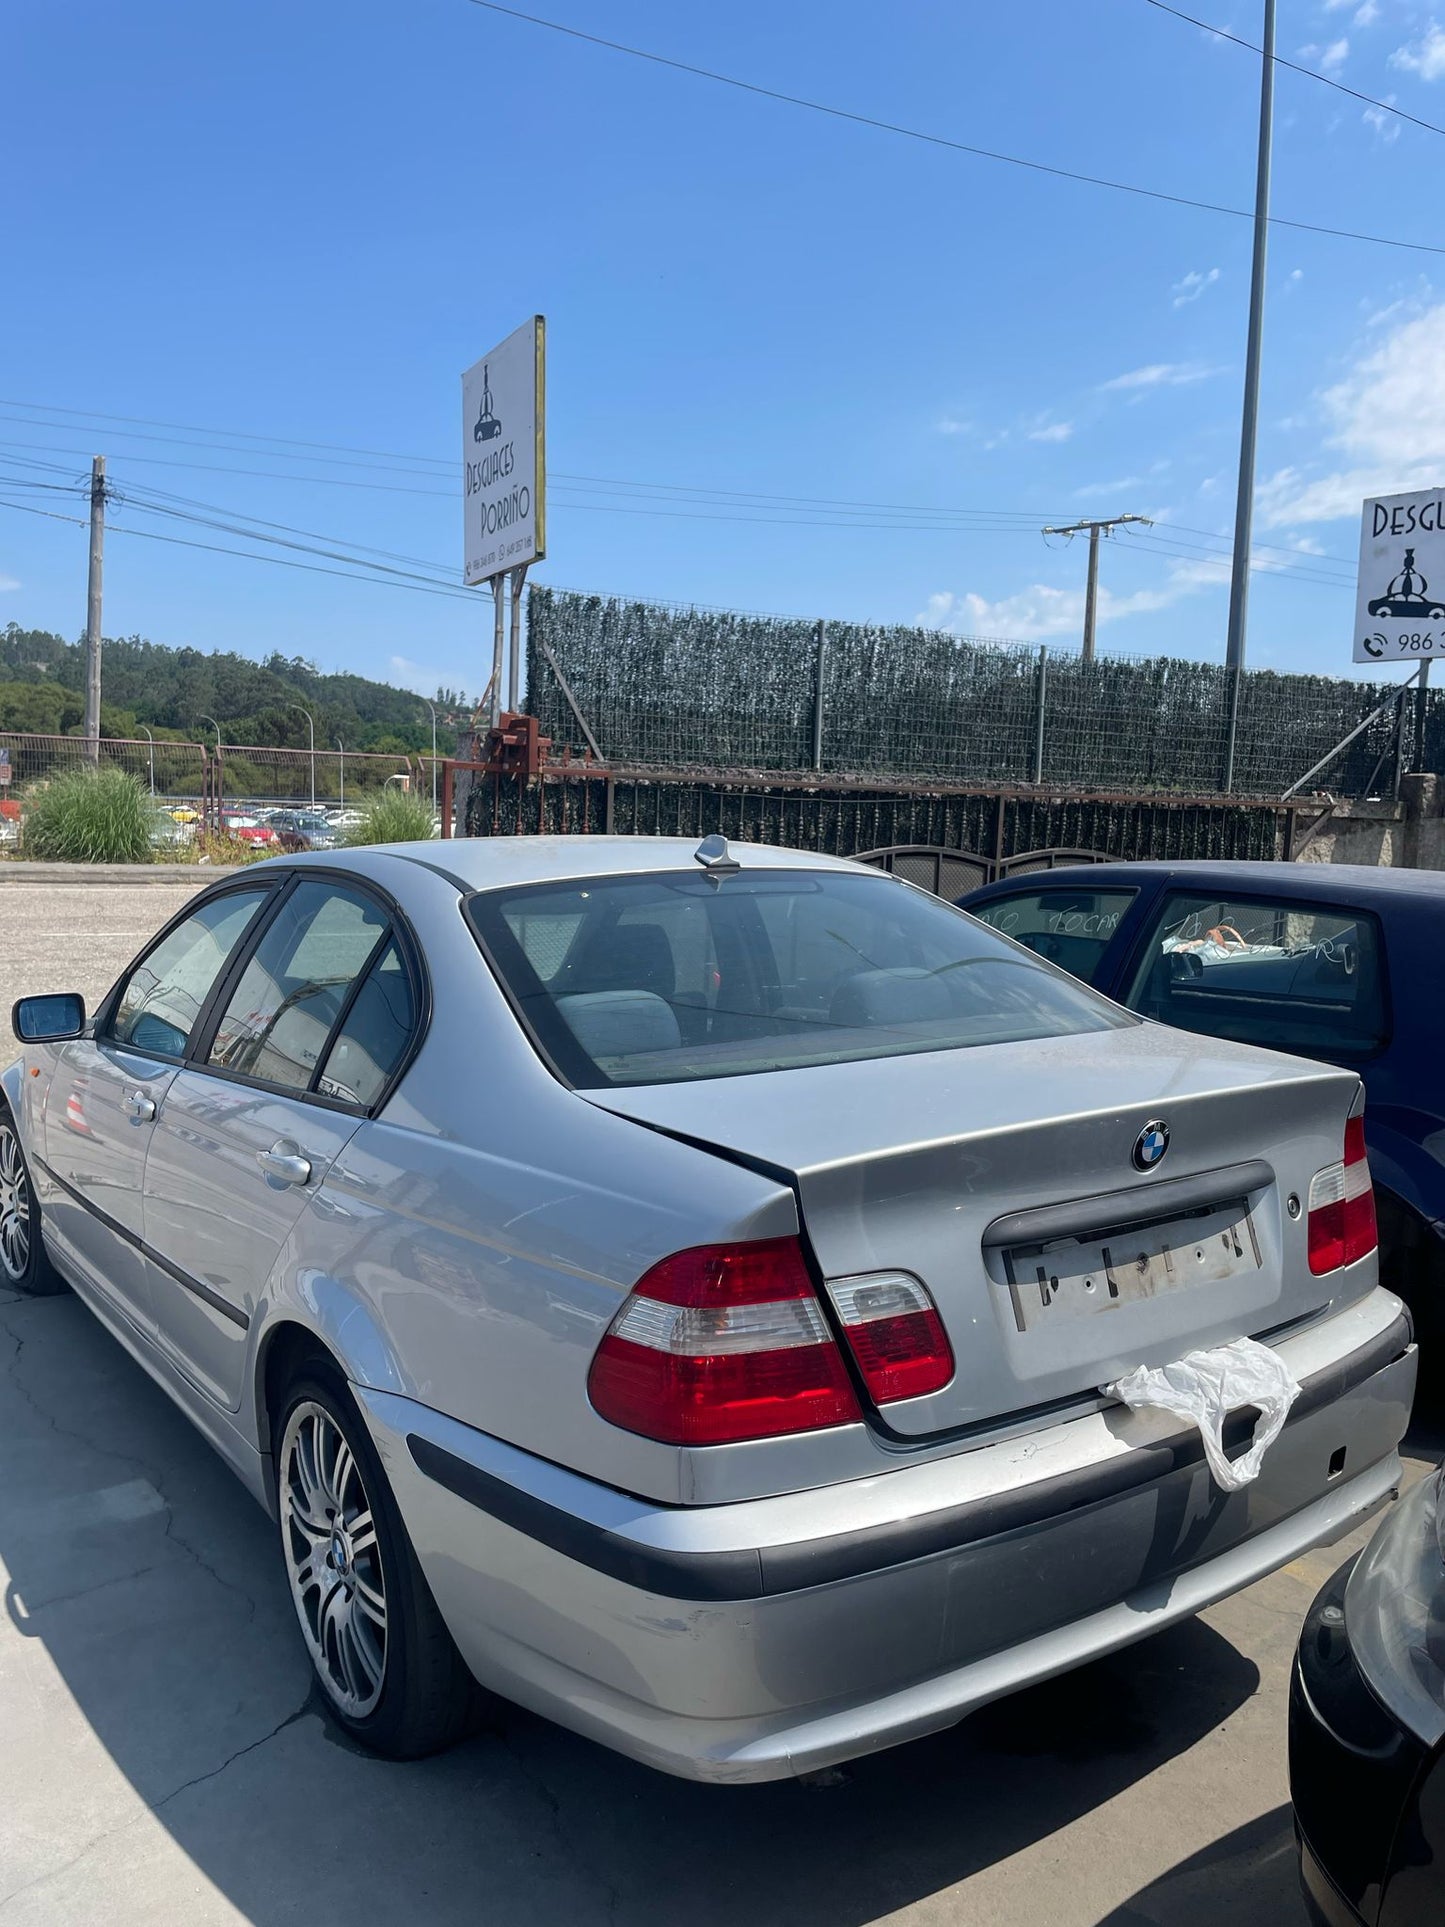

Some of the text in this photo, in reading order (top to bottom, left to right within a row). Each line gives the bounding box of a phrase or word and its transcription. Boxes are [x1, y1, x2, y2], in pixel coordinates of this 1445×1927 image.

[467, 441, 514, 497] DESGUACES
[481, 484, 530, 539] PORRIÑO
[1398, 633, 1433, 652] 986
[1049, 905, 1120, 933] TOCAR
